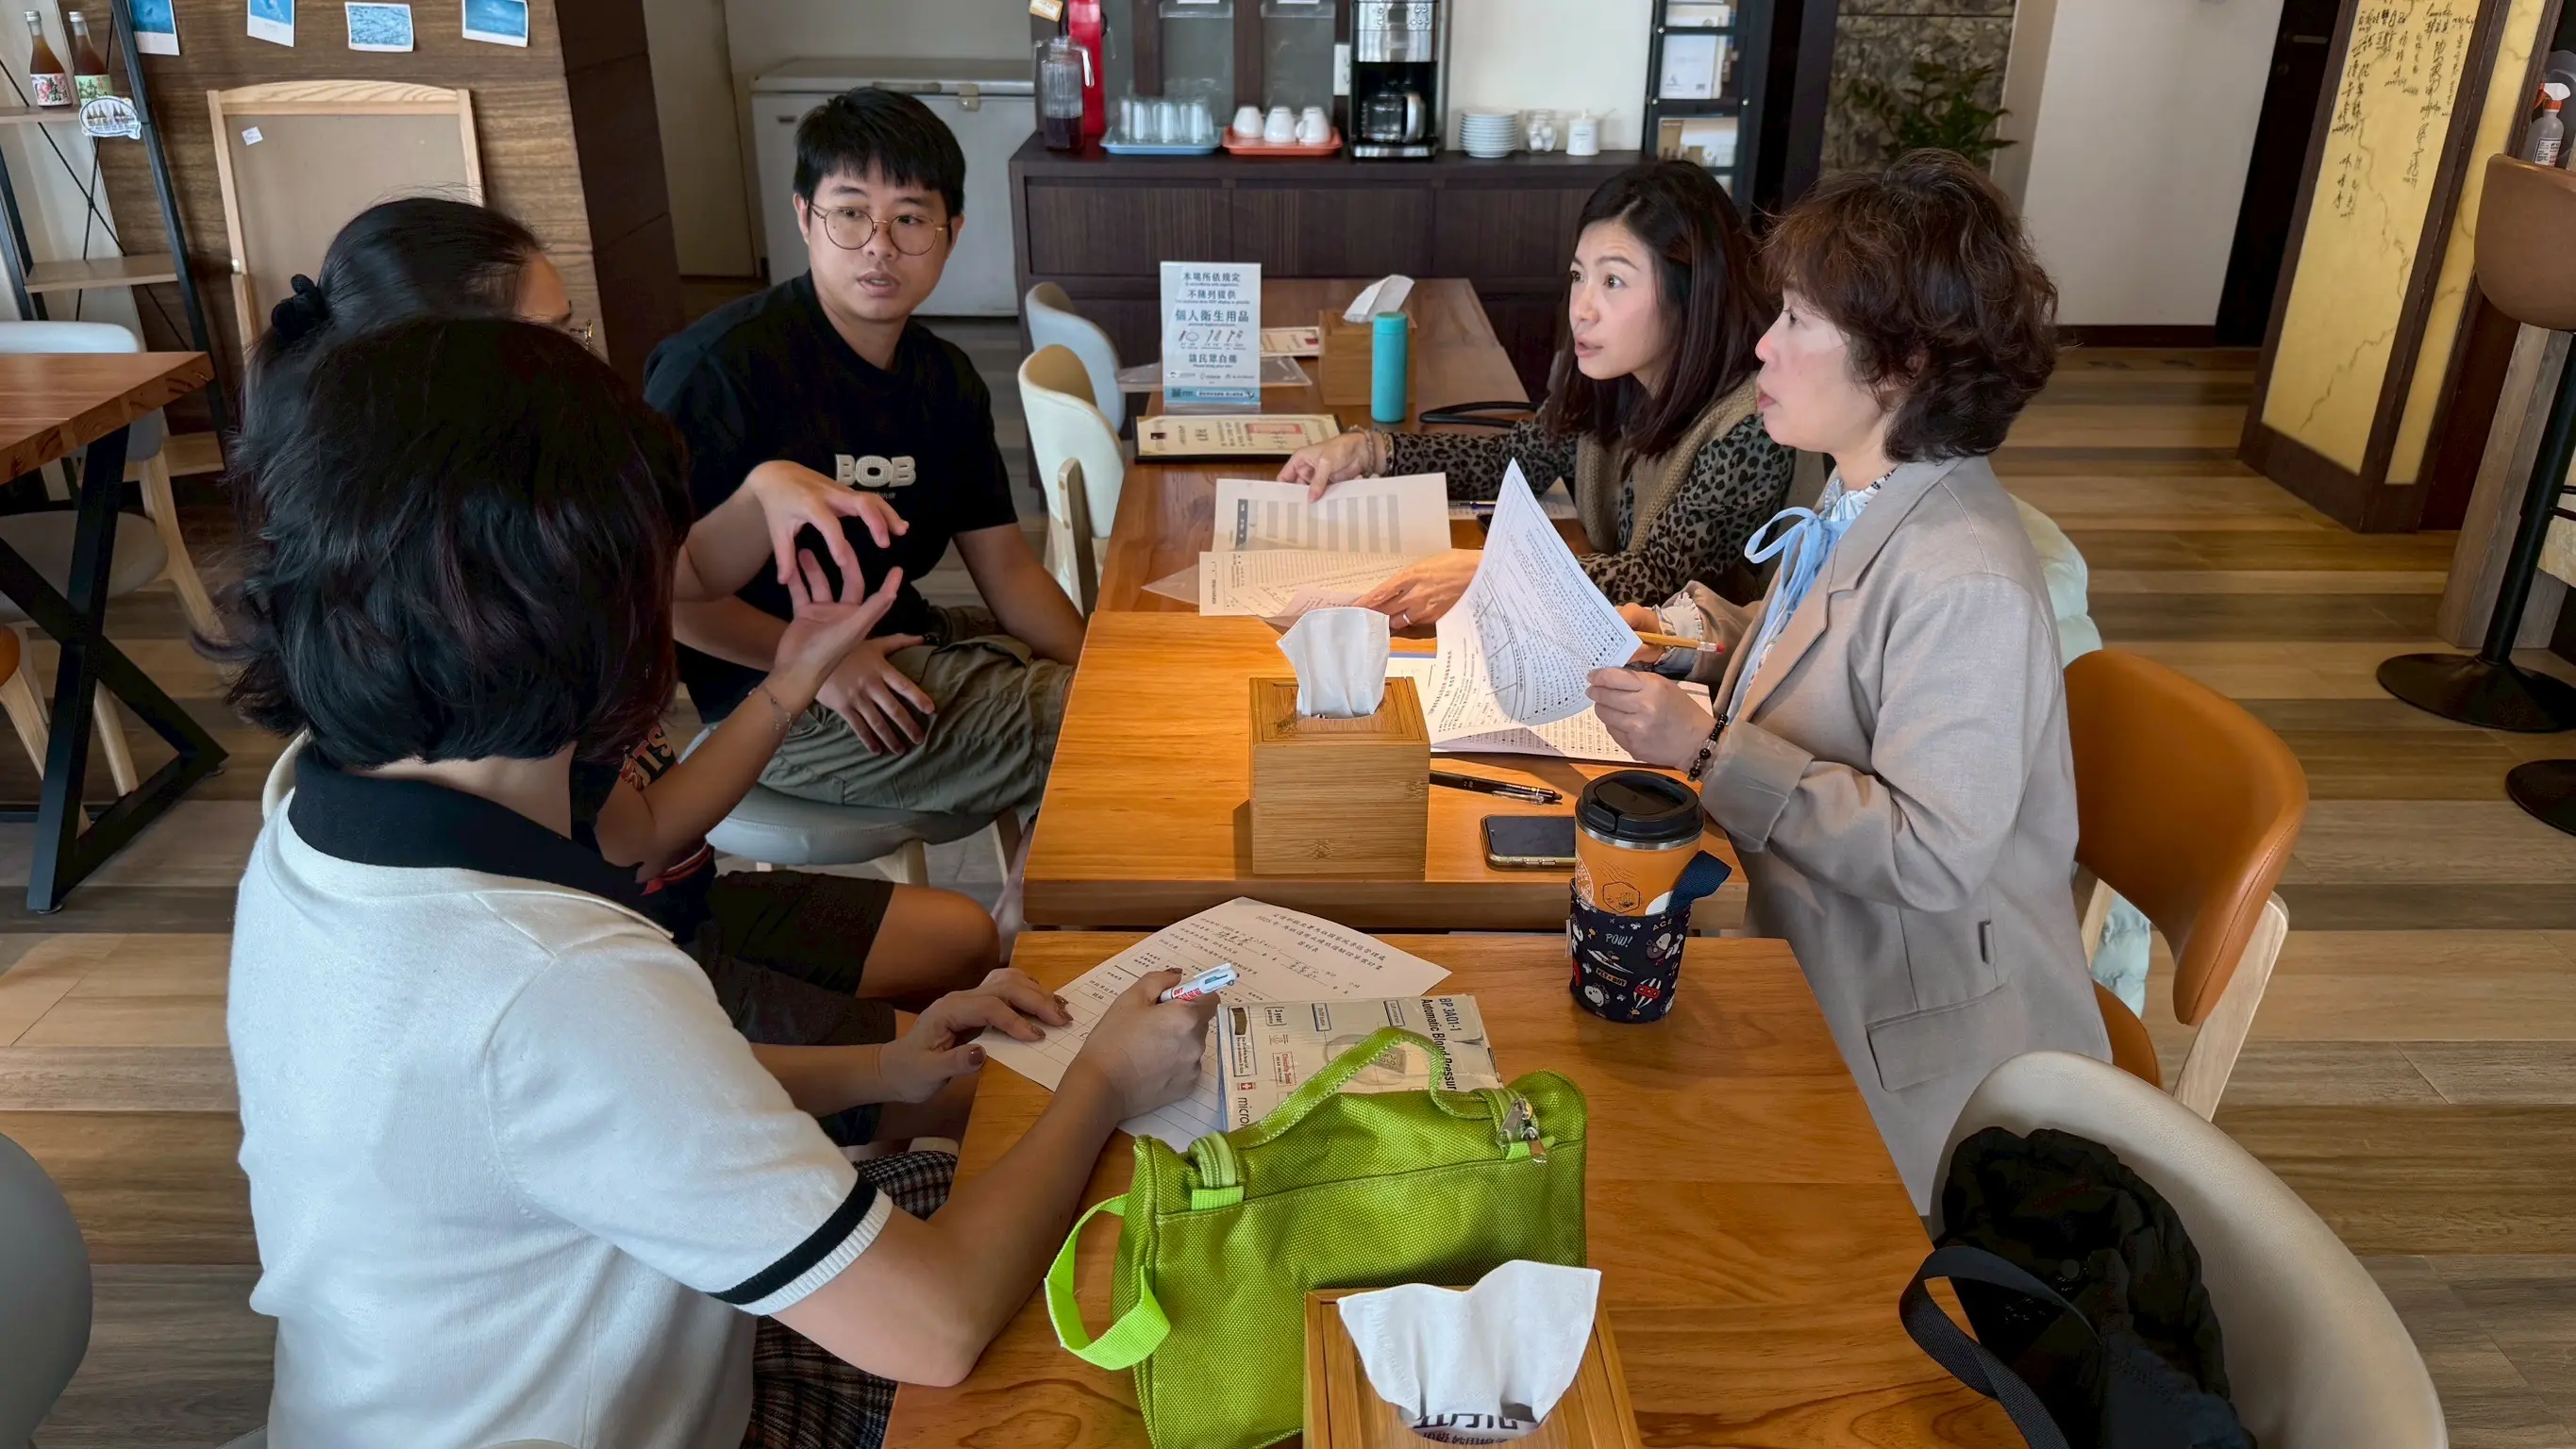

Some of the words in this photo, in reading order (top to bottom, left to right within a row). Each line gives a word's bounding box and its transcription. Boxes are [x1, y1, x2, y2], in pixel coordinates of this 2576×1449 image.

[1175, 308, 1249, 323] 個人衛生用品
[835, 454, 916, 488] BOB
[1605, 933, 1633, 948] POW!
[1439, 997, 1453, 1008] BP
[1421, 998, 1443, 1032] Automatic
[1432, 1033, 1450, 1057] Blood
[1443, 1058, 1457, 1091] Pressur
